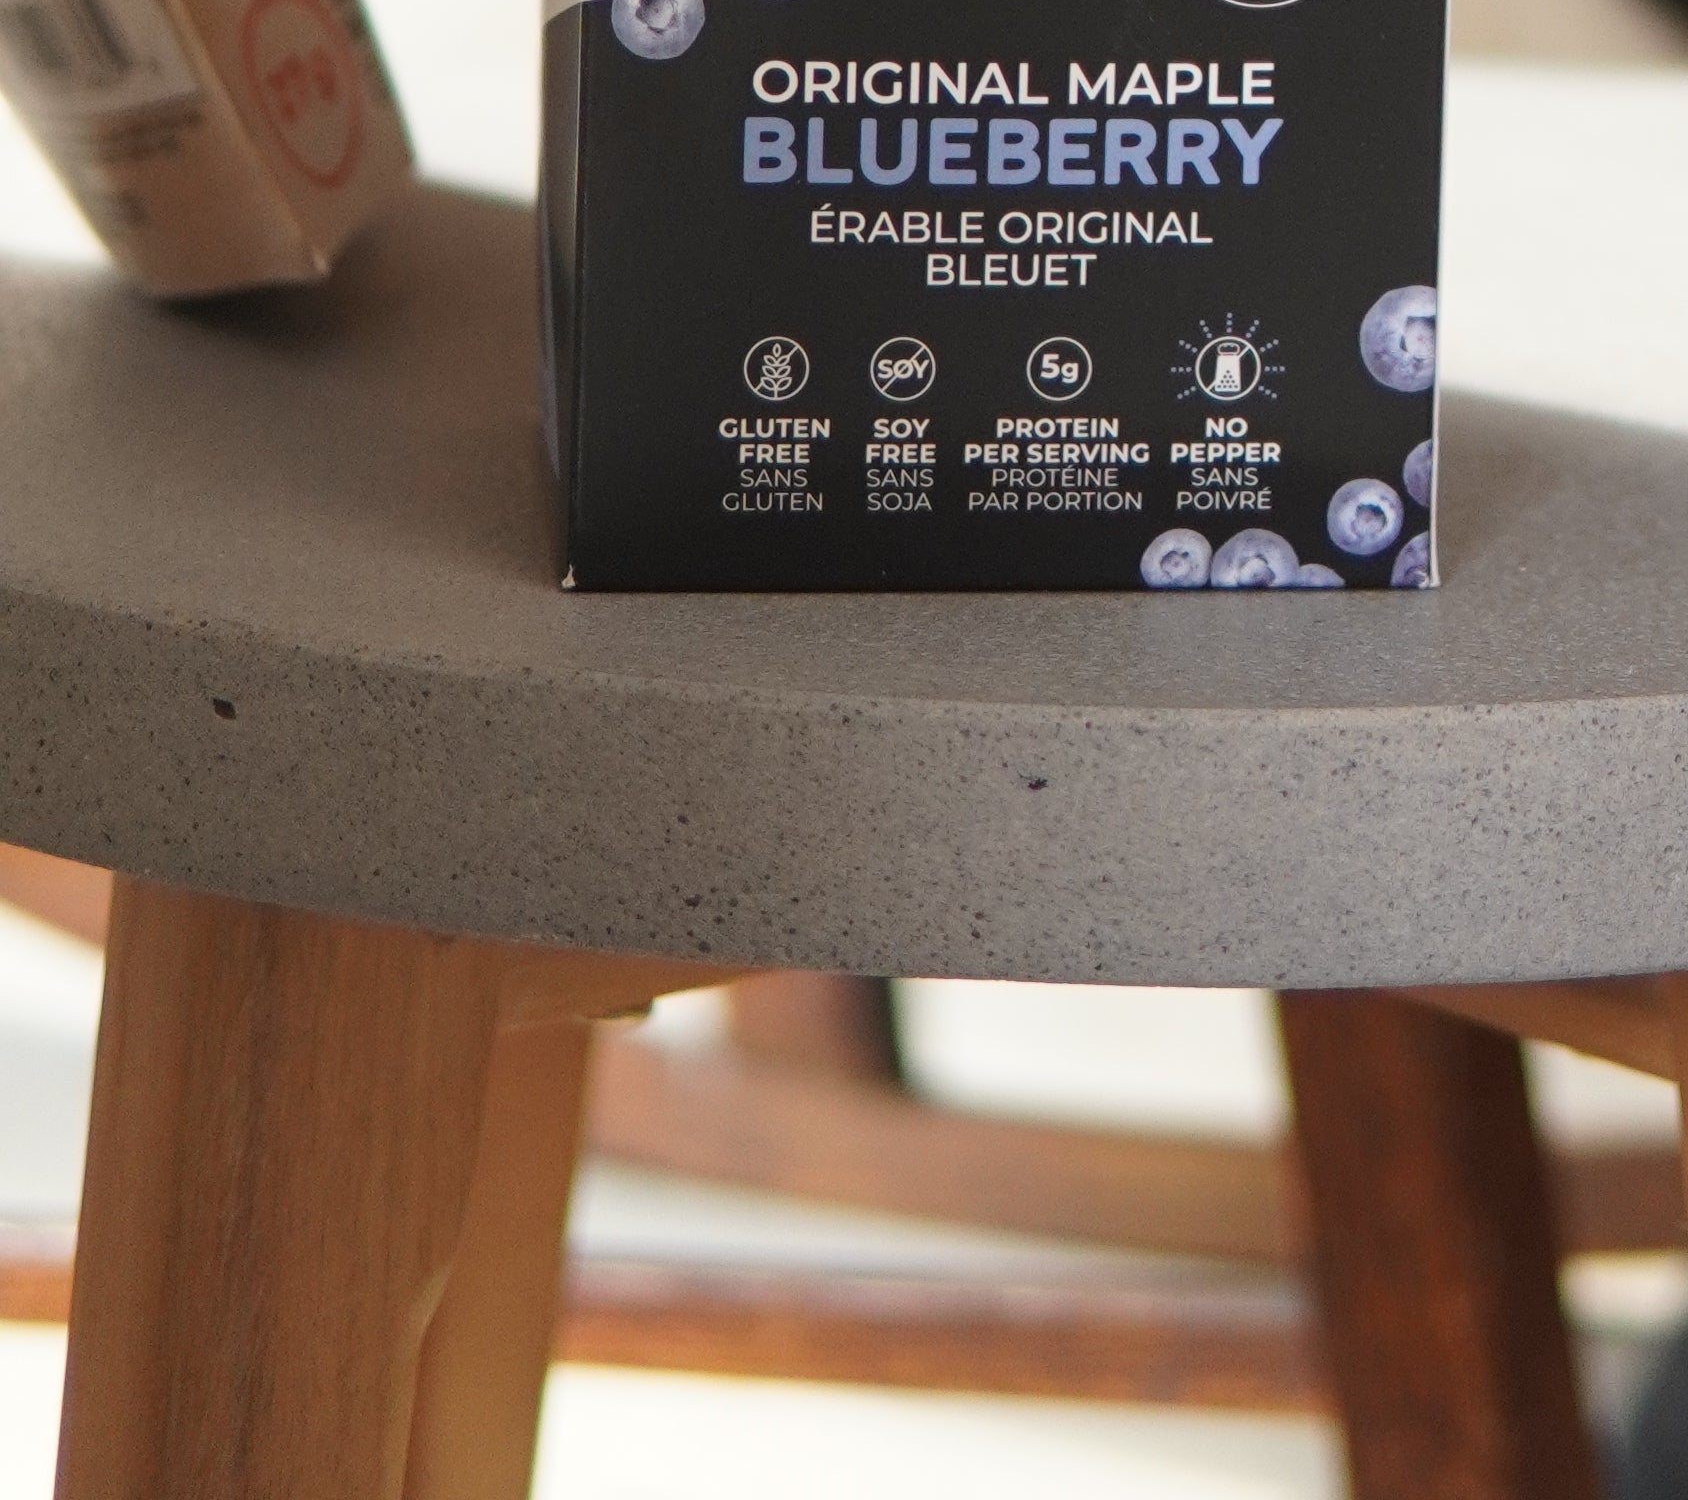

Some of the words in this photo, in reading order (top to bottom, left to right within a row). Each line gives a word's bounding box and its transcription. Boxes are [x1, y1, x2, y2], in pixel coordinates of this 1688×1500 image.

[753, 60, 1049, 104] ORIGINAL
[1069, 63, 1274, 105] MAPLE
[744, 117, 1284, 185] BLUEBERRY
[811, 203, 984, 243] ÉRABLE
[999, 212, 1213, 244] ORIGINAL
[927, 254, 1097, 286] BLEUET
[1040, 354, 1079, 384] 5g
[719, 418, 830, 438] GLUTEN
[874, 419, 929, 438] SOY
[997, 418, 1118, 438] PROTEIN
[1206, 418, 1248, 437] NO
[740, 444, 810, 464] FREE
[866, 444, 936, 463] FREE
[965, 444, 1019, 463] PER
[1027, 443, 1149, 463] SERVING
[1171, 442, 1281, 463] PEPPER
[741, 469, 807, 487] SANS
[867, 469, 933, 487] SANS
[993, 465, 1118, 487] PROTÉINE
[1192, 467, 1258, 486] SANS
[723, 493, 822, 511] GLUTEN
[868, 492, 932, 511] SOJA
[969, 492, 1018, 510] PAR
[1027, 492, 1142, 511] PORTION
[1177, 487, 1271, 510] POIVRÉ
